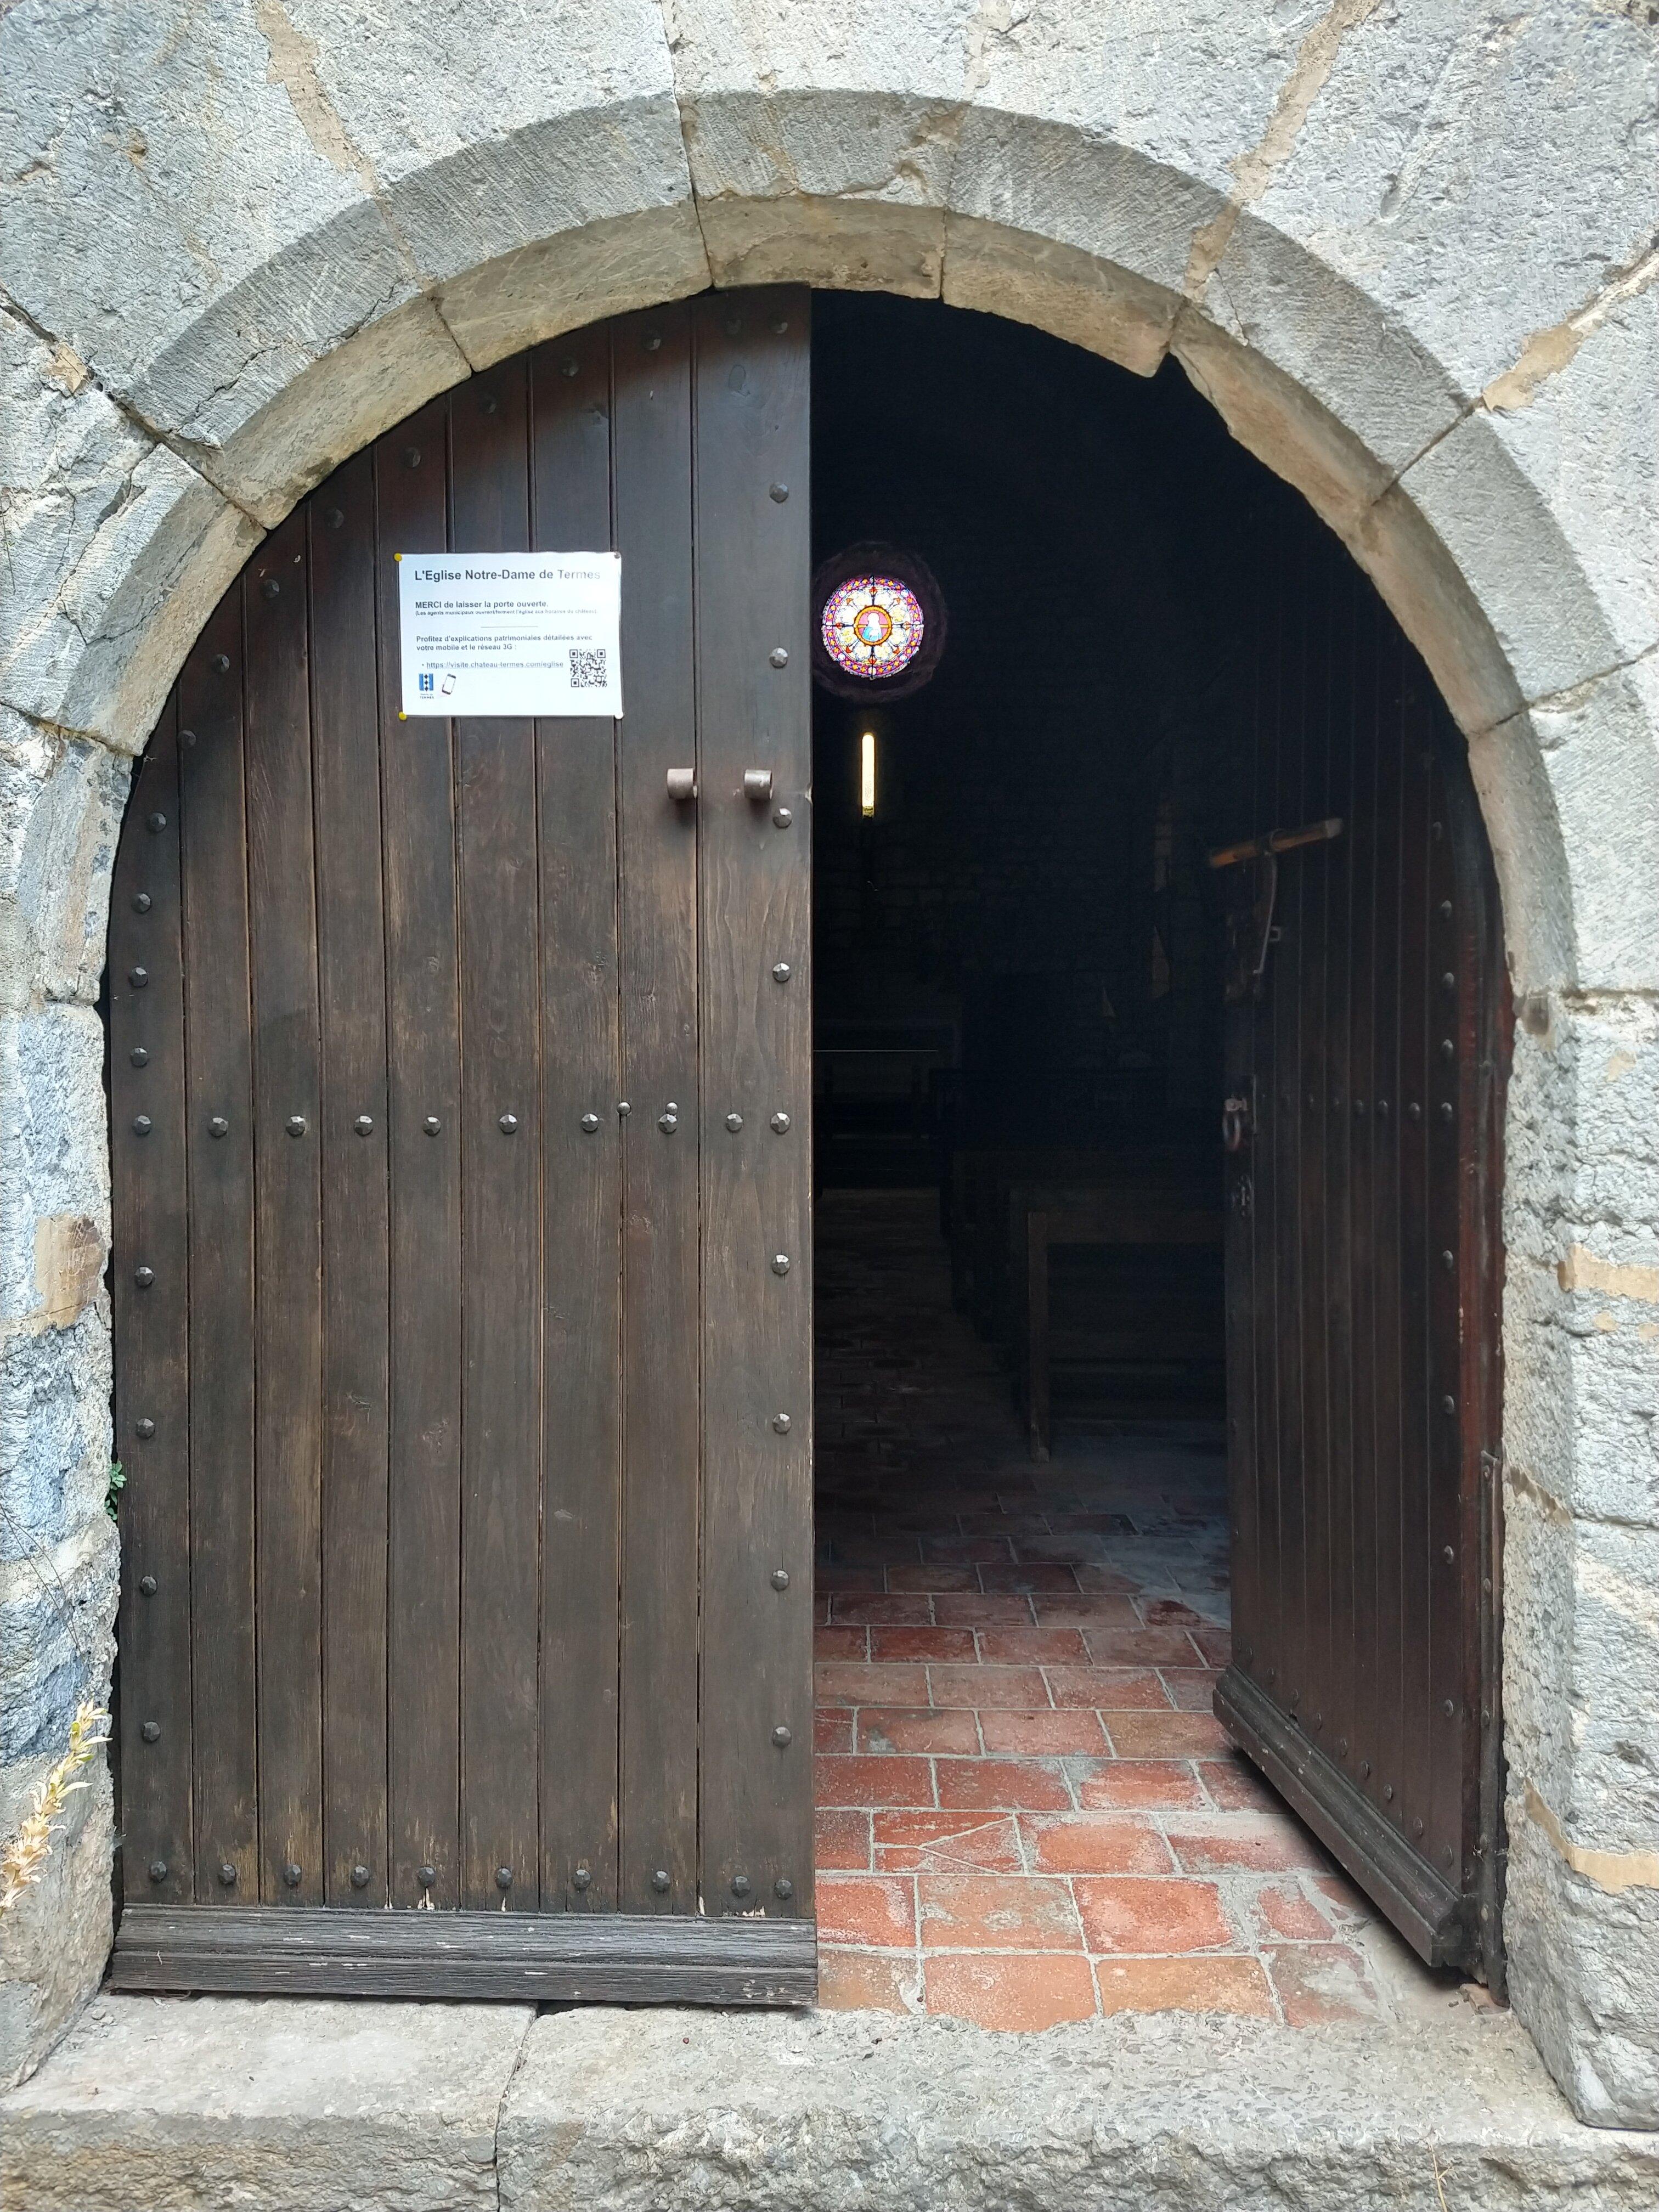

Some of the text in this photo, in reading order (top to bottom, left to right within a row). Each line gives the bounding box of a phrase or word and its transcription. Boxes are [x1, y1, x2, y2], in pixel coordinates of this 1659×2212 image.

[415, 569, 600, 582] L'Eglise Notre-Dame de Termes
